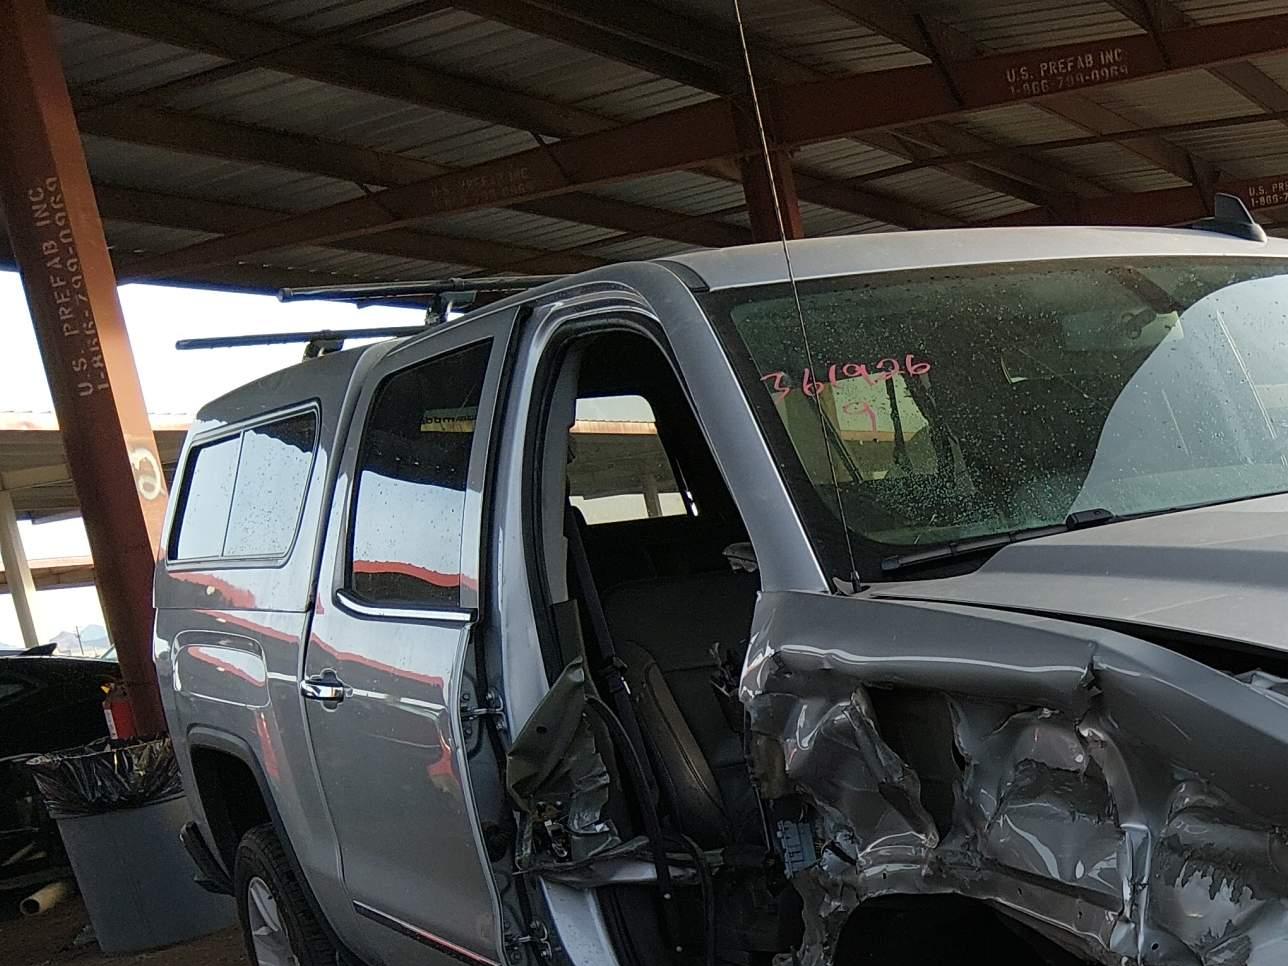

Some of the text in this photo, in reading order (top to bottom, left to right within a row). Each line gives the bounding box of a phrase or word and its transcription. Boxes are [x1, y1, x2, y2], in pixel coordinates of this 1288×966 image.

[1006, 66, 1034, 83] U.S.
[1039, 53, 1094, 77] PREFAB
[1248, 185, 1268, 198] U.S.
[28, 186, 94, 397] U.S. PREFAB INC
